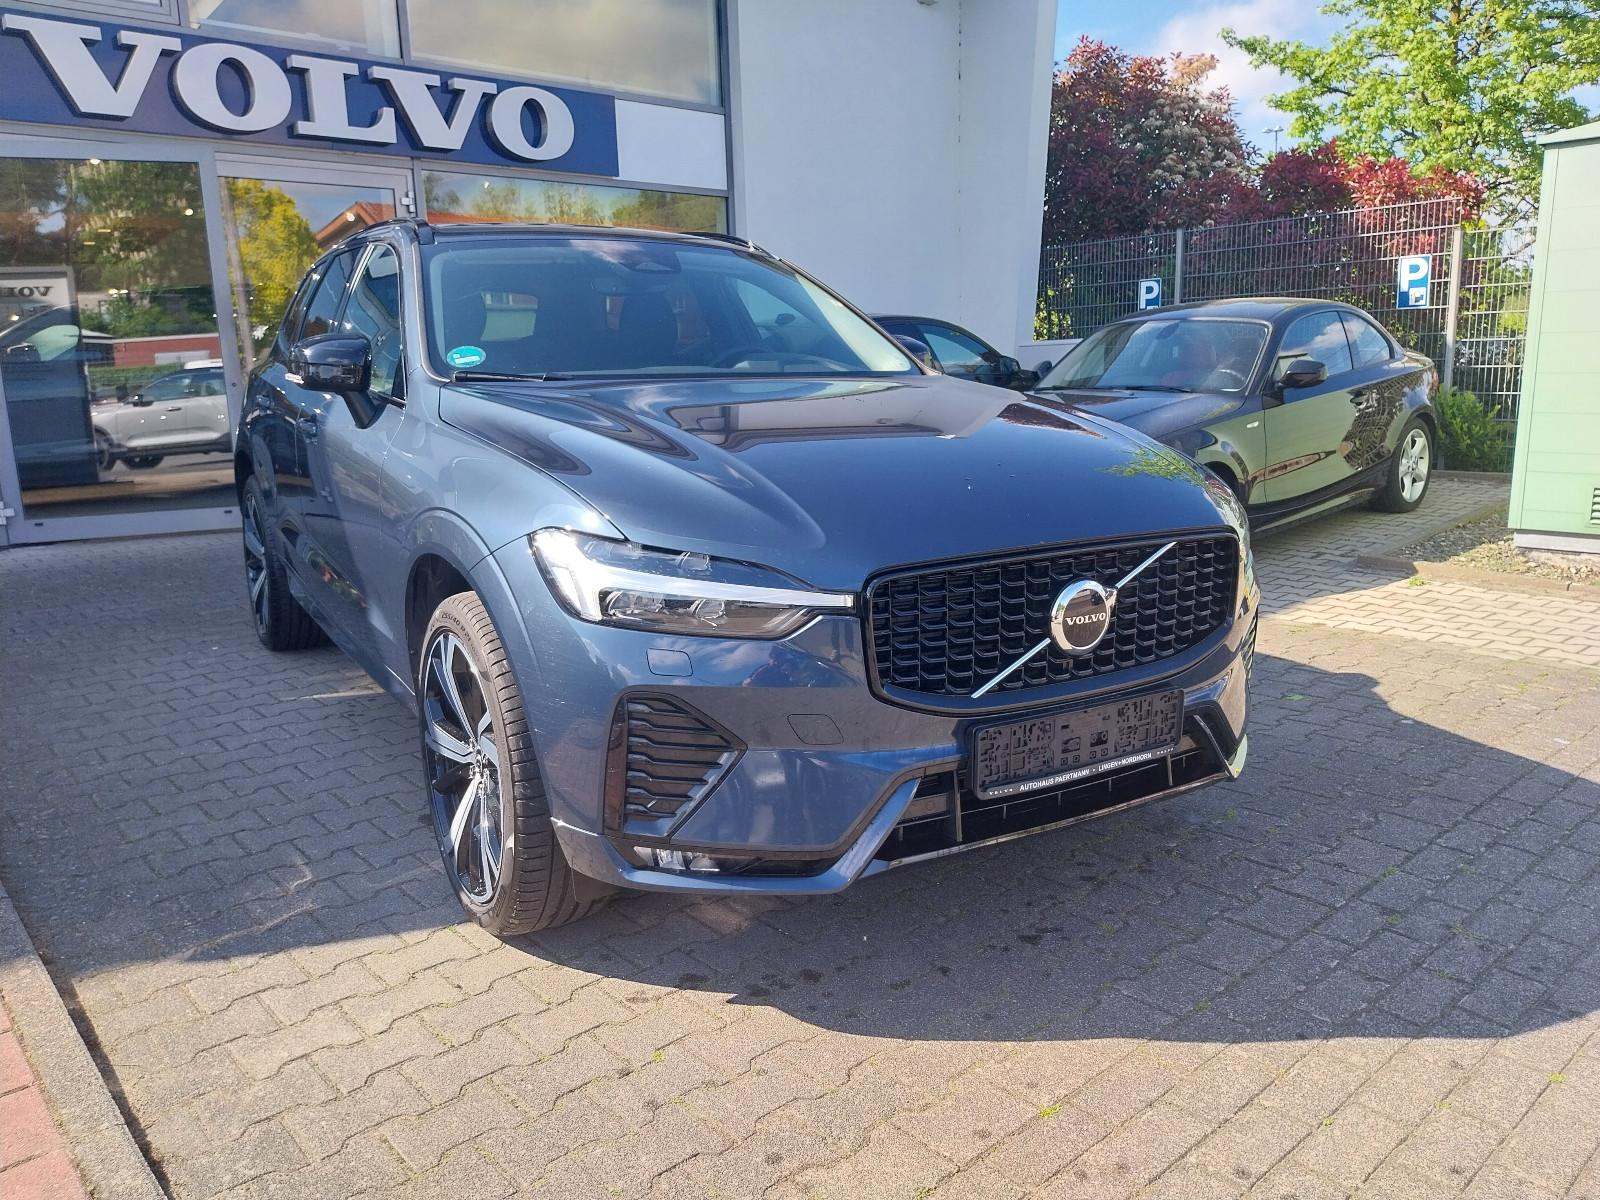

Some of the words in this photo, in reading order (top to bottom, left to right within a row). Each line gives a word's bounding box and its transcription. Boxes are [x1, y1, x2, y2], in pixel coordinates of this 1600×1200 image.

[2, 13, 575, 161] VOLVO
[1400, 257, 1428, 292] P
[1140, 280, 1159, 309] P
[1065, 612, 1106, 626] VOLVO
[1019, 777, 1055, 792] AUTOHAUS
[1054, 768, 1090, 784] PAERTMANN
